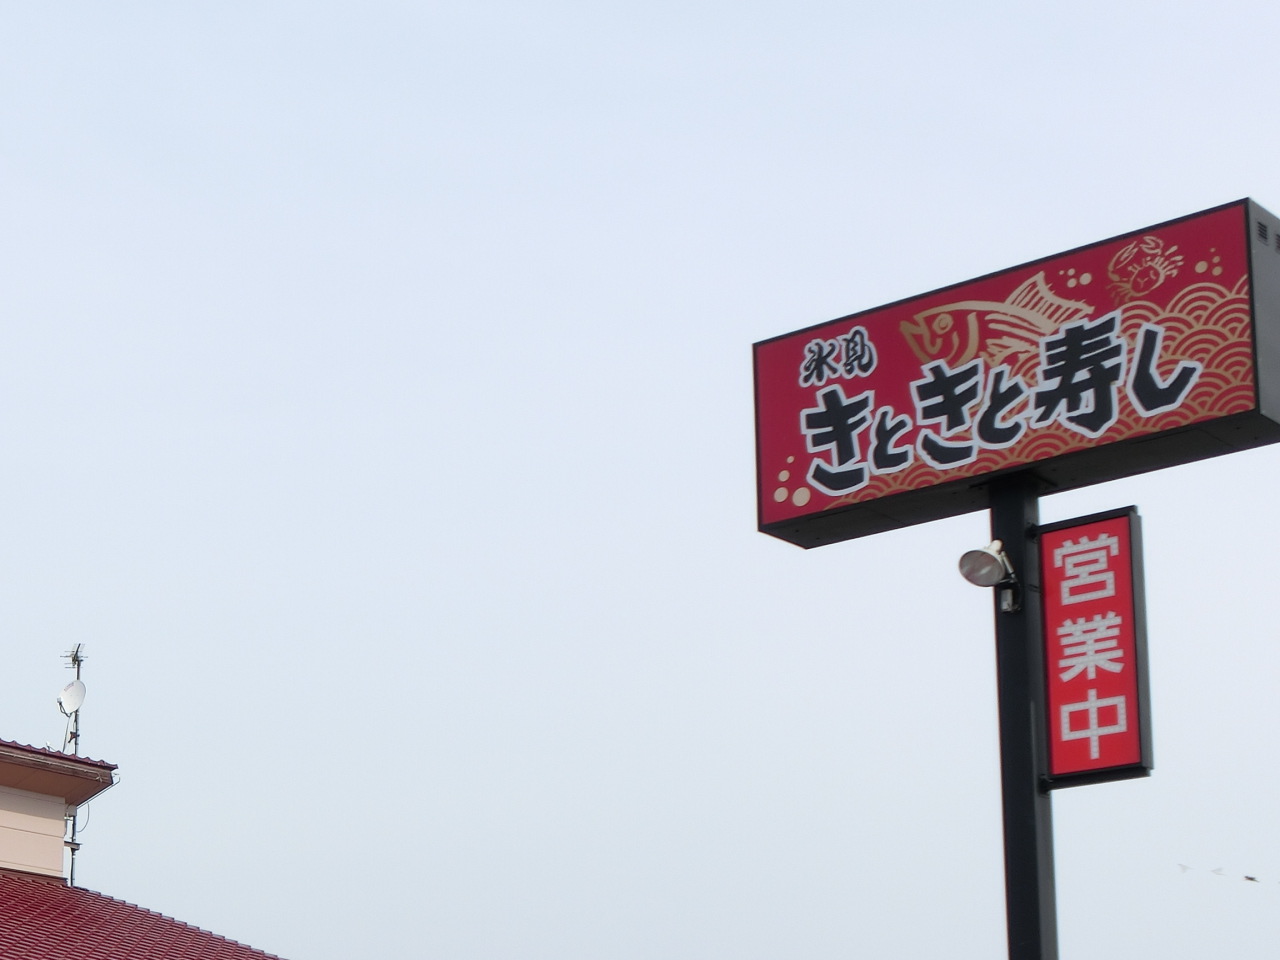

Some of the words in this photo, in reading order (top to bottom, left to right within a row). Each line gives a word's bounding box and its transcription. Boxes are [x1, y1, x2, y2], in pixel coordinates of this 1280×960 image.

[801, 328, 876, 387] 氷見
[802, 312, 1202, 494] きときと寿し
[1053, 533, 1128, 760] 営業中
